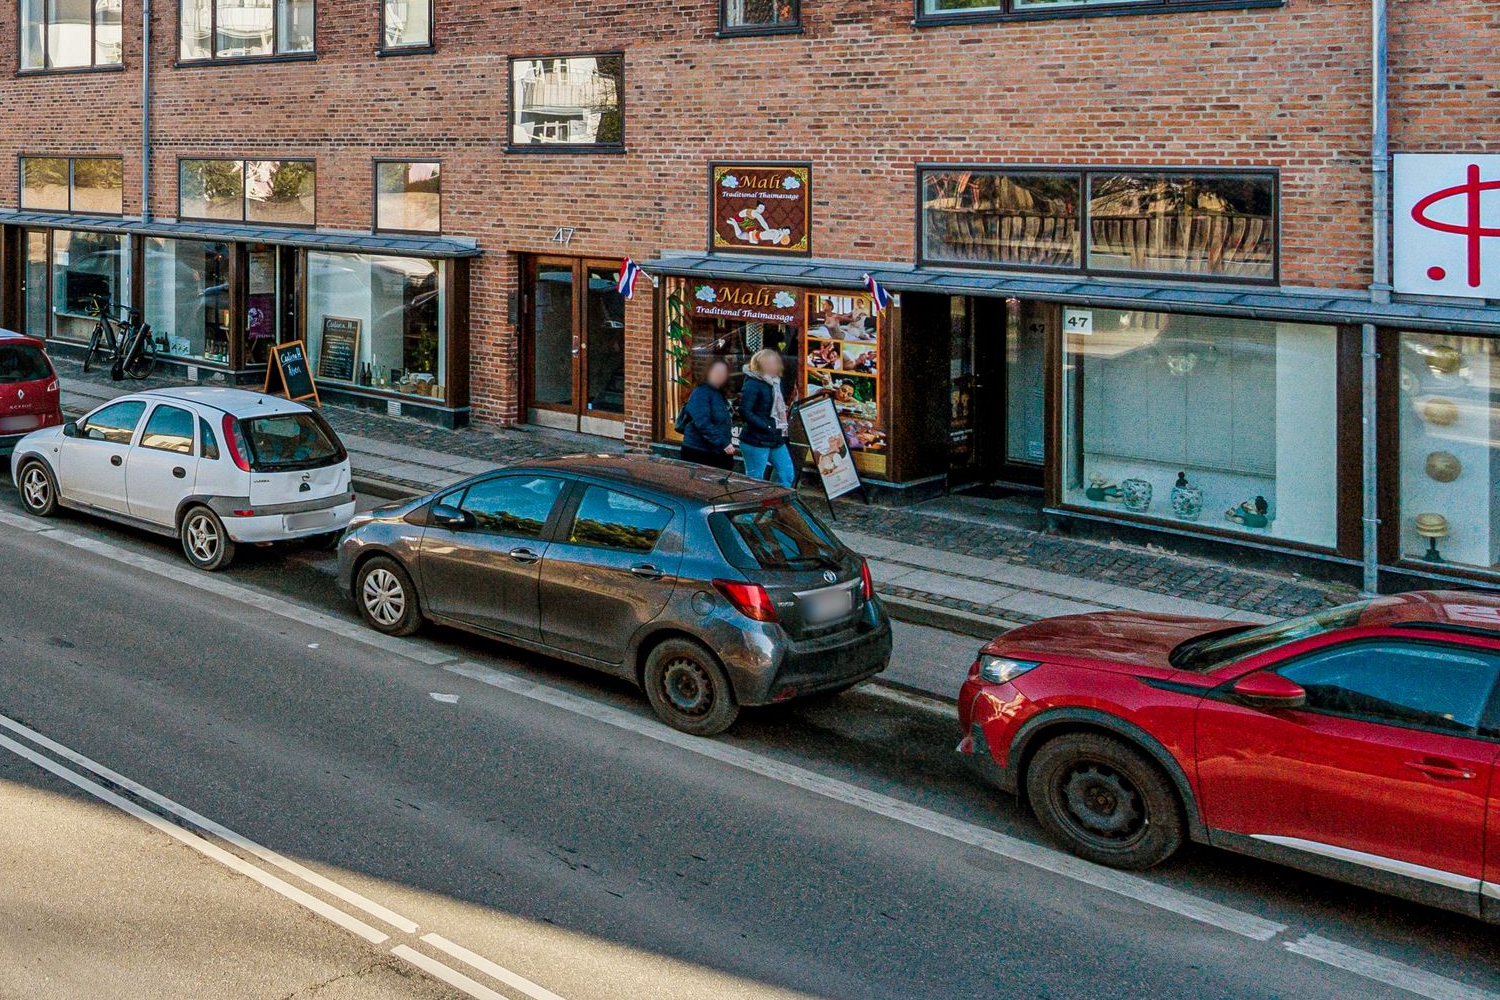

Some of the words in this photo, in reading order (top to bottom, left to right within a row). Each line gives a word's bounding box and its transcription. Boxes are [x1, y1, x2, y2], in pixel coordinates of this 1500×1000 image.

[739, 174, 781, 189] Mali
[759, 192, 799, 200] Thaimassage
[552, 227, 574, 244] 47
[716, 286, 771, 306] Mali
[696, 305, 741, 316] Traditional
[742, 309, 794, 323] Thaimassage
[1068, 316, 1088, 328] 47
